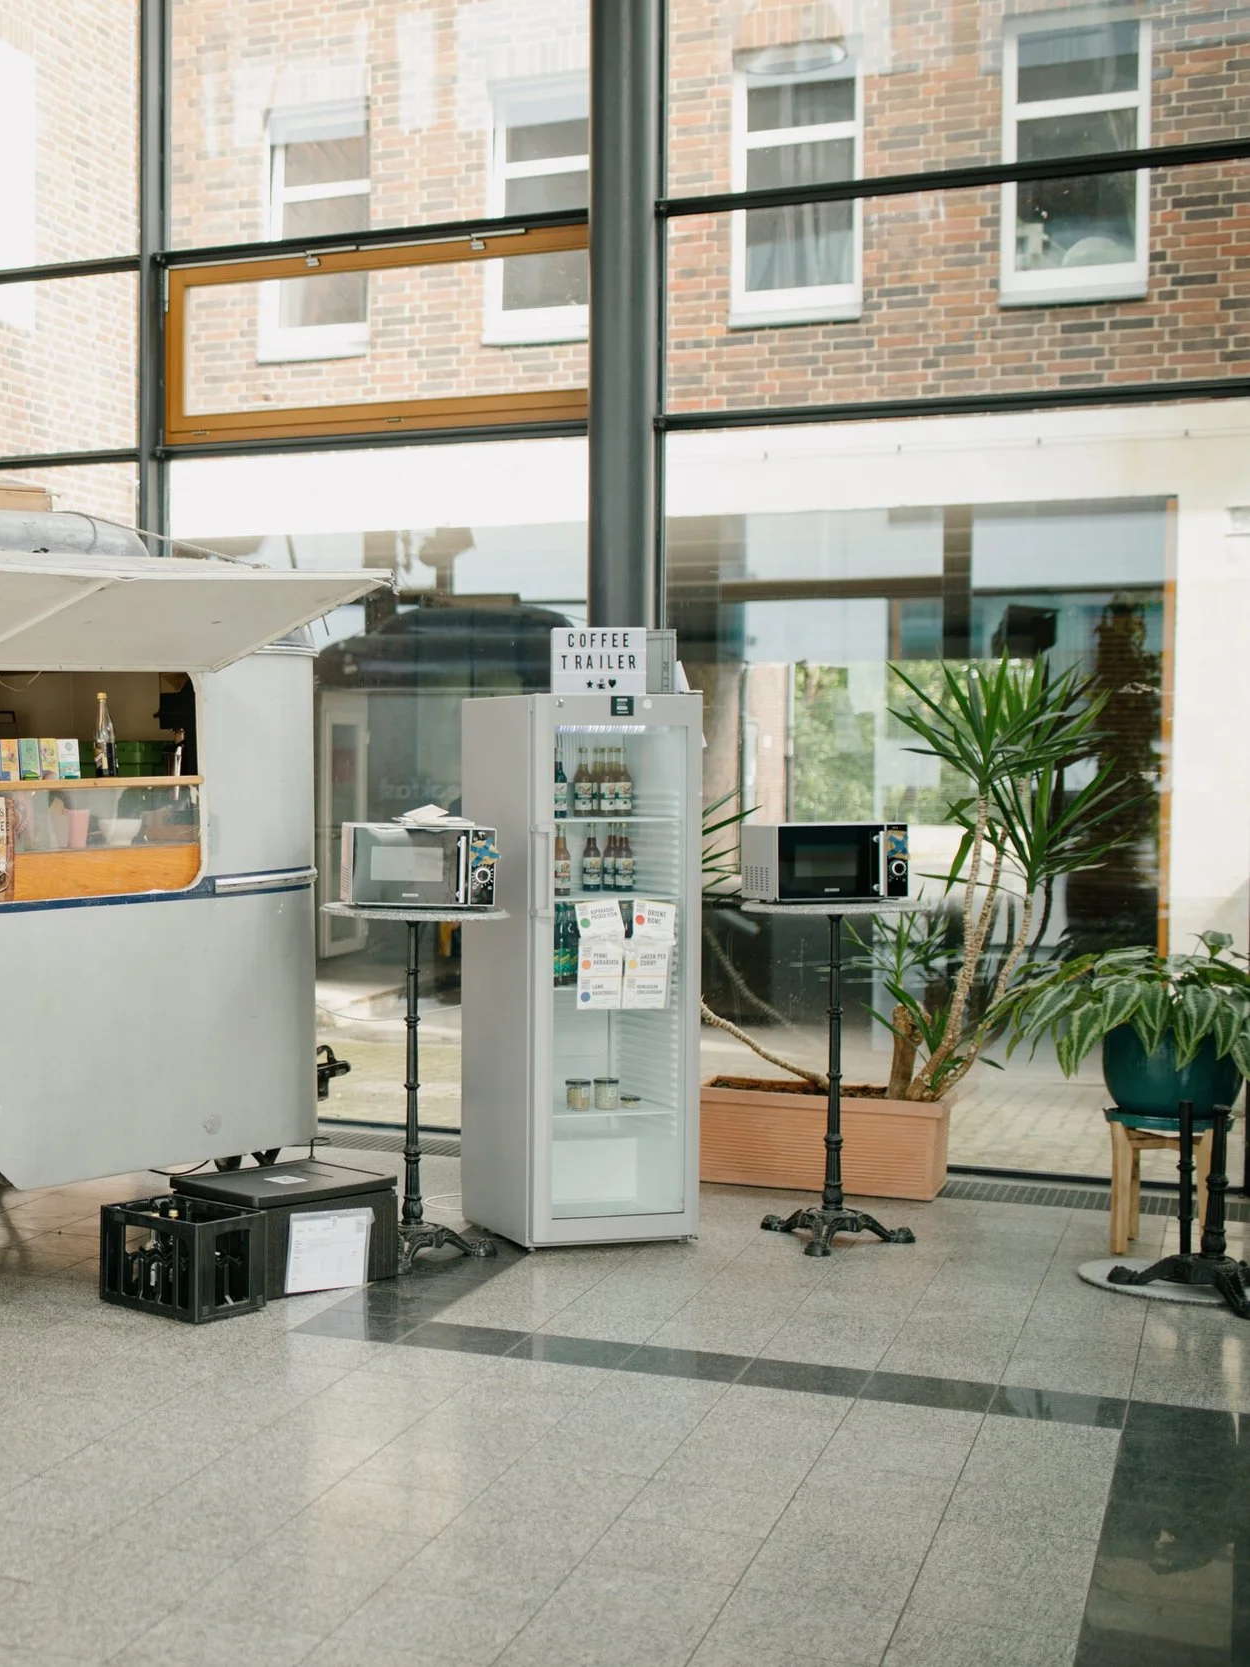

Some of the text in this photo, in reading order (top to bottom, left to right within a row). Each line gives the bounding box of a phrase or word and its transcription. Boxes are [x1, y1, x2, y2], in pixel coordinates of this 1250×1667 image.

[568, 633, 630, 648] COFFEE
[561, 654, 637, 669] TRAILER
[648, 909, 667, 918] ORIENT
[647, 917, 662, 925] BOWL
